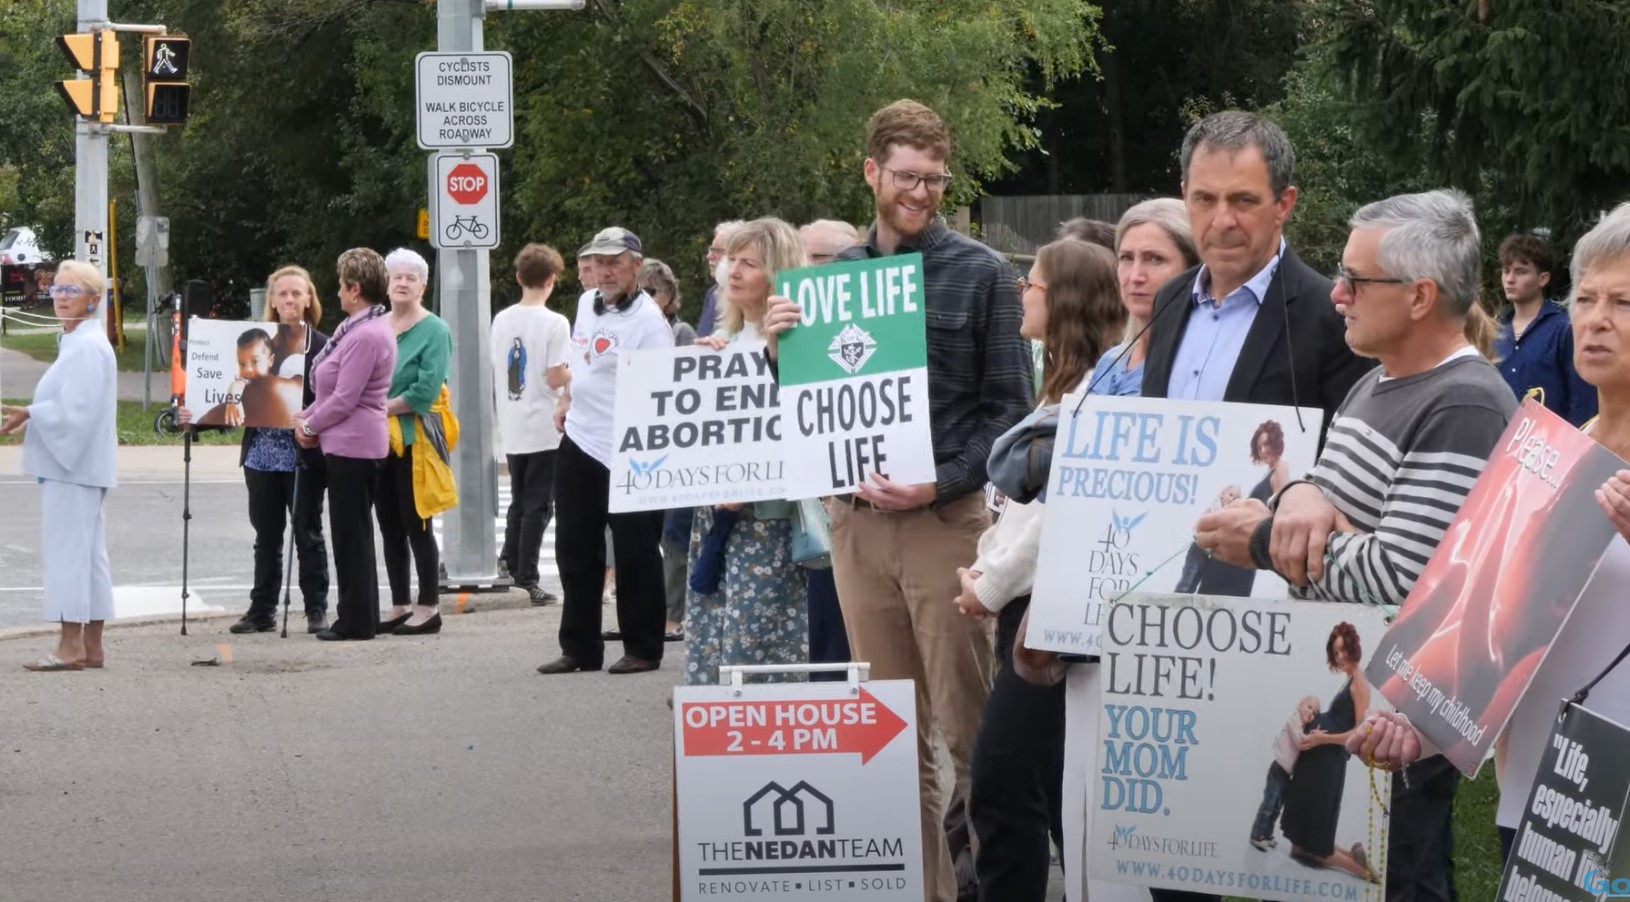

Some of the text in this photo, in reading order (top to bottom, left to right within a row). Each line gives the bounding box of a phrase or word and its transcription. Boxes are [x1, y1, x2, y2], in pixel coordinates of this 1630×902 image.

[437, 75, 492, 86] DISMOUNT
[439, 62, 490, 72] CYCLISTS
[426, 101, 504, 112] WALK BICYCLE
[443, 115, 488, 126] ACROSS
[439, 128, 492, 139] ROADWAY
[449, 176, 485, 192] STOP
[860, 264, 918, 318] LIFE
[191, 352, 219, 361] Defend
[673, 351, 768, 382] PRAY
[196, 367, 223, 380] Save
[205, 388, 241, 405] Lives
[651, 388, 702, 417] TO
[797, 375, 912, 437] CHOOSE
[618, 414, 782, 453] ABORTIO
[1061, 409, 1222, 467] LIFE IS
[828, 434, 889, 489] LIFE
[616, 460, 785, 495] 40 DAYS FOR LI
[1056, 465, 1199, 505] PRECIOUS!
[1097, 522, 1131, 553] 40
[1088, 550, 1140, 577] DAYS
[1107, 602, 1292, 656] CHOOSE
[1106, 652, 1217, 702] LIFE!
[1385, 643, 1488, 747] Let me keep my childhood
[685, 702, 877, 728] OPEN HOUSE
[1104, 704, 1199, 745] YOUR
[726, 731, 744, 752] 2
[767, 730, 786, 751] 4
[793, 728, 838, 750] PM
[1102, 740, 1189, 781] MOM
[1101, 776, 1171, 817] DID.
[1531, 784, 1618, 854] especially
[1128, 834, 1160, 853] DAYS
[1162, 838, 1190, 856] FOR
[1189, 841, 1219, 858] LIFE
[1517, 821, 1576, 881] human
[698, 877, 906, 894] RENOVATE LIST SOLD
